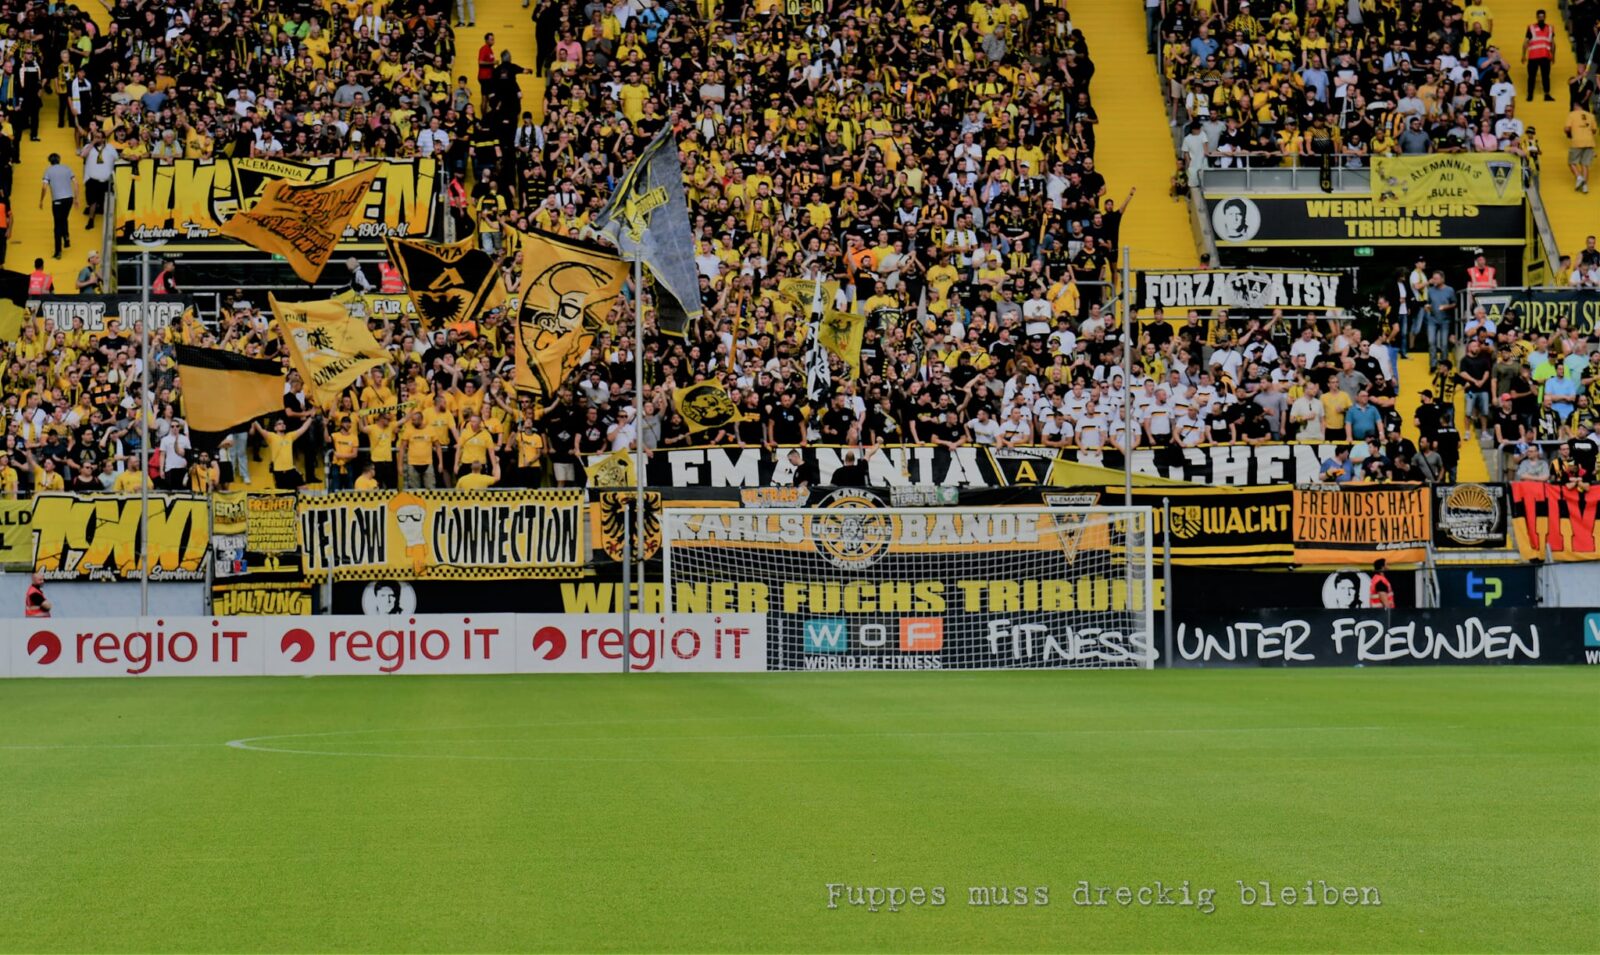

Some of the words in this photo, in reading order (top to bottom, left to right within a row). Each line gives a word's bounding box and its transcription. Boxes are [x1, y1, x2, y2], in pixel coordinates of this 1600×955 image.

[238, 156, 303, 177] ALEMANNIA
[1306, 200, 1400, 218] WERNER
[1405, 204, 1480, 218] FUCHS
[1345, 217, 1442, 238] TRIBÜNE
[1145, 273, 1227, 308] FORZA
[1269, 273, 1339, 308] ATSV
[1511, 300, 1600, 335] GIRBELS
[1202, 504, 1291, 534] WACHT
[1300, 489, 1423, 517] FREUNDSCHAFT
[301, 505, 386, 569] YELLOW
[432, 504, 578, 564] CONNECTION
[670, 513, 804, 543] KARLS
[900, 513, 1040, 545] BANDE
[1298, 514, 1425, 543] ZUSAMMENHALT
[223, 590, 301, 615] HALTUNG
[560, 582, 769, 614] WERNER
[783, 582, 945, 613] FUCHS
[75, 619, 198, 675] regio
[329, 617, 450, 673] regio
[581, 616, 701, 670] regio
[987, 618, 1159, 662] FITNESS
[1177, 619, 1315, 662] UNTER
[1331, 616, 1540, 660] FREUNDEN
[804, 655, 856, 670] WORLD
[861, 655, 878, 670] OF
[882, 655, 941, 670] FITNESS
